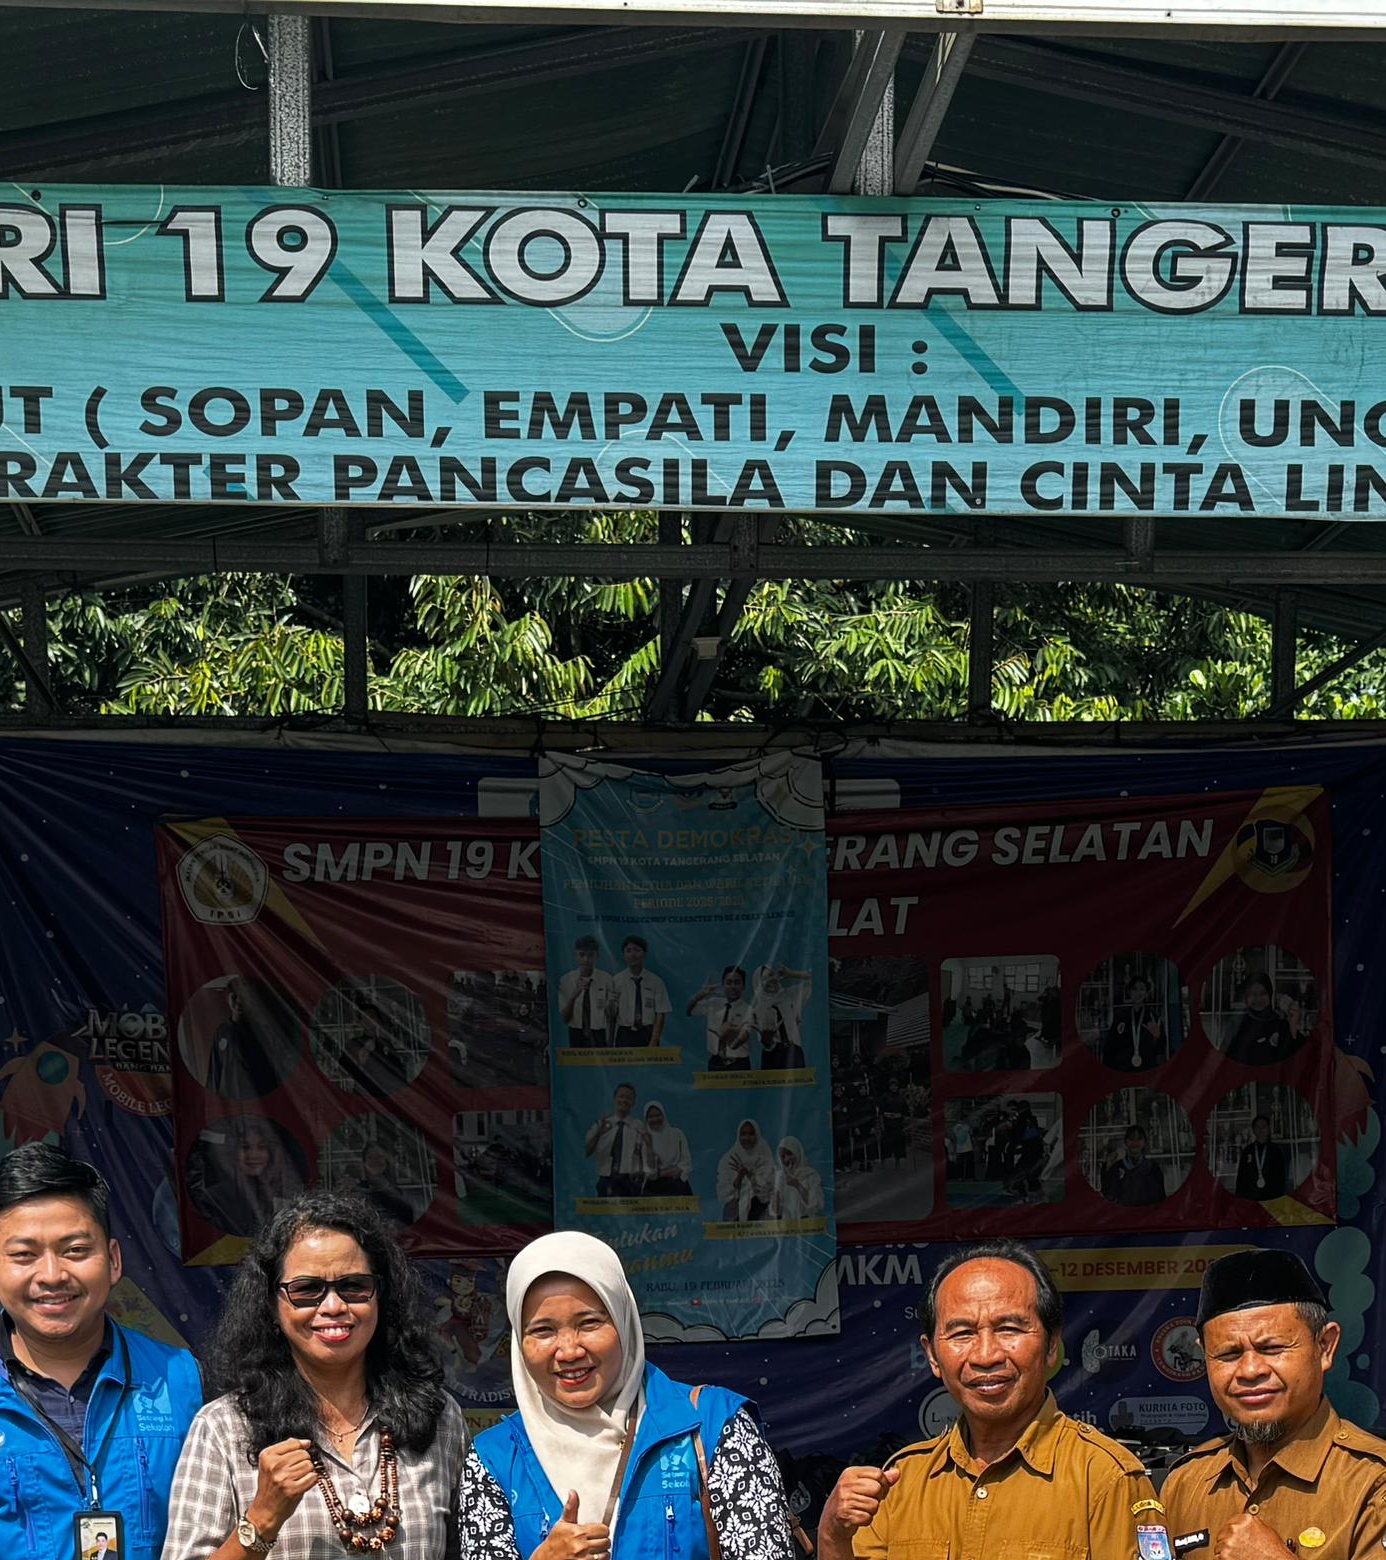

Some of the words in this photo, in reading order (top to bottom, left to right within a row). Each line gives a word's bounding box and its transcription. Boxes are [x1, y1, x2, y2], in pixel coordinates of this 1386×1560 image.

[156, 204, 338, 304] 19
[388, 204, 790, 309] KOTA
[720, 323, 877, 374] VISI
[139, 386, 452, 449] SOPAN,
[484, 391, 797, 452] EMPATI,
[824, 395, 1208, 456] MANDIRI,
[334, 453, 786, 508] PANCASILA
[815, 459, 987, 510] DAN
[1019, 461, 1255, 513] CINTA
[282, 841, 432, 883] SMPN
[445, 840, 495, 881] 19
[507, 839, 541, 880] K
[991, 819, 1214, 867] SELATAN
[574, 830, 649, 849] PESTA
[631, 857, 660, 866] KOTA
[662, 855, 730, 866] TANGERANG
[733, 853, 781, 864] SELATAN
[827, 896, 919, 937] LAT
[88, 1009, 168, 1040] MOB
[89, 1038, 171, 1062] LEGEN
[102, 1073, 146, 1113] MOBILE
[148, 1098, 173, 1113] LEG
[1082, 1260, 1178, 1277] DESEMBER
[1183, 1258, 1215, 1274] 20
[460, 1385, 515, 1402] TRADIS
[1139, 1403, 1178, 1412] KURNIA
[1181, 1402, 1206, 1411] FOTO
